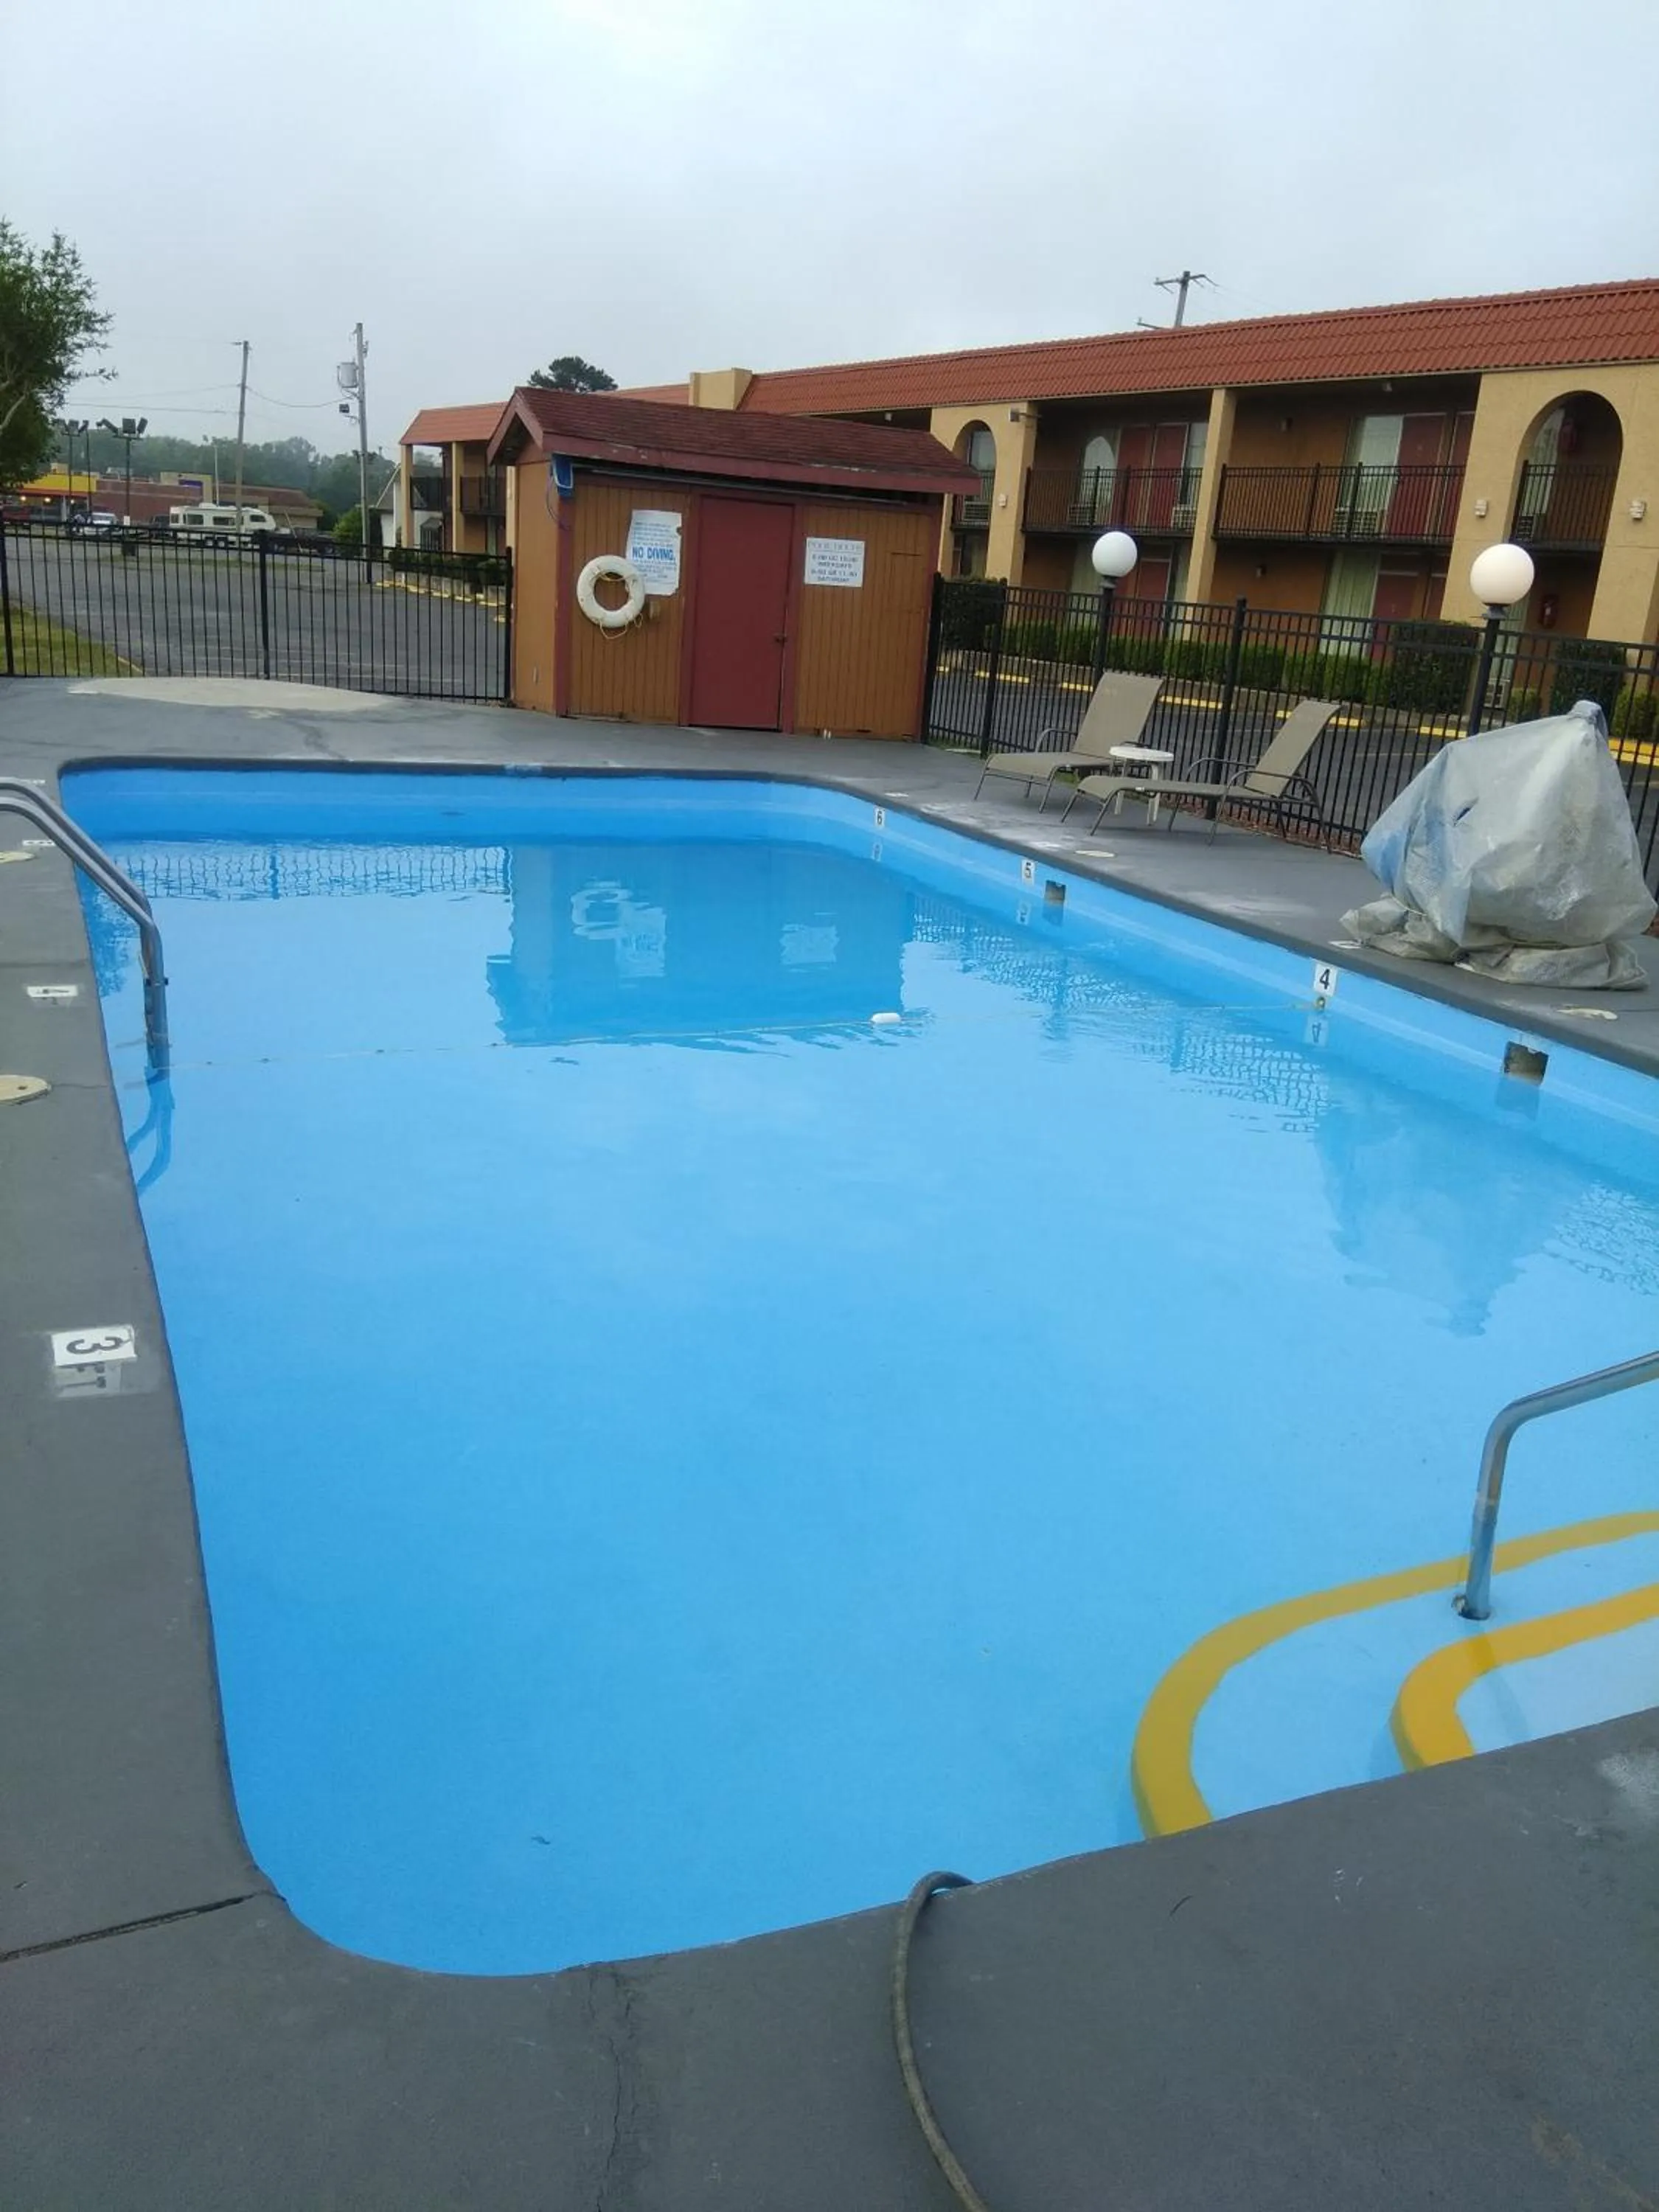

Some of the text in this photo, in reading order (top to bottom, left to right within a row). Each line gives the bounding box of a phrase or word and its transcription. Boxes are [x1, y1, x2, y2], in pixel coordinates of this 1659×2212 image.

[632, 546, 644, 558] NO
[1023, 862, 1032, 878] 5
[1319, 968, 1330, 990] 4
[66, 1336, 123, 1354] 3
